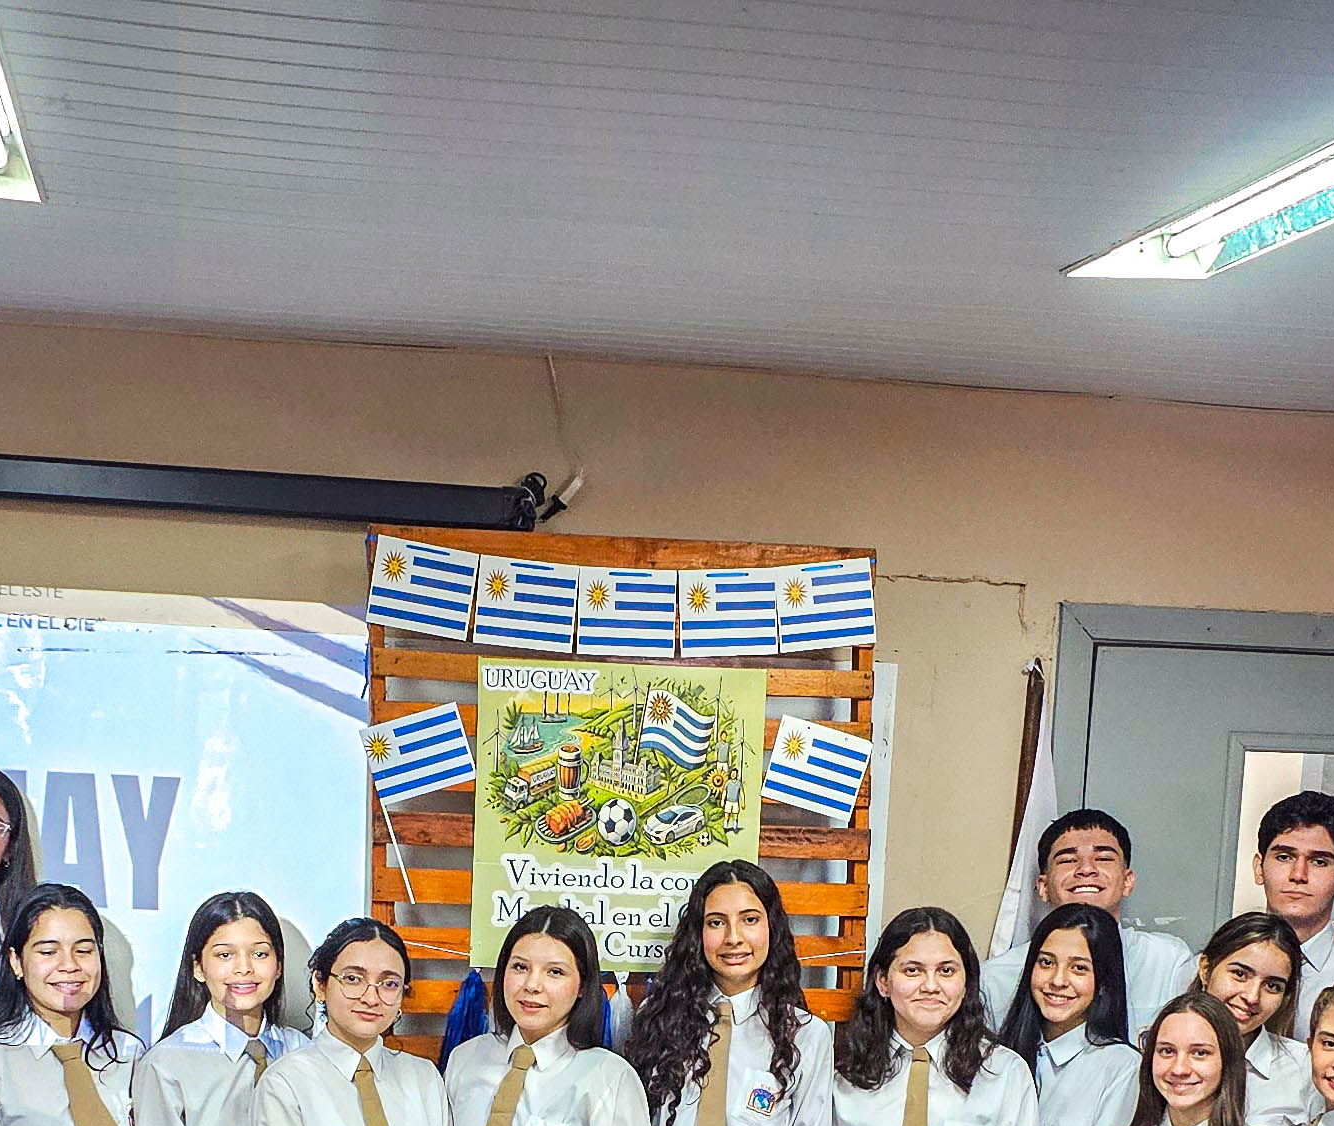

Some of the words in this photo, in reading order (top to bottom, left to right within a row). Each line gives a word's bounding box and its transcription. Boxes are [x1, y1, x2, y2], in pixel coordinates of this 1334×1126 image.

[7, 614, 33, 629] EN
[37, 616, 61, 631] EL
[483, 667, 599, 693] URUGUAY
[506, 858, 625, 889] Viviendo
[630, 863, 654, 890] la
[612, 912, 642, 927] en
[648, 902, 671, 928] el
[604, 931, 665, 958] Curs
